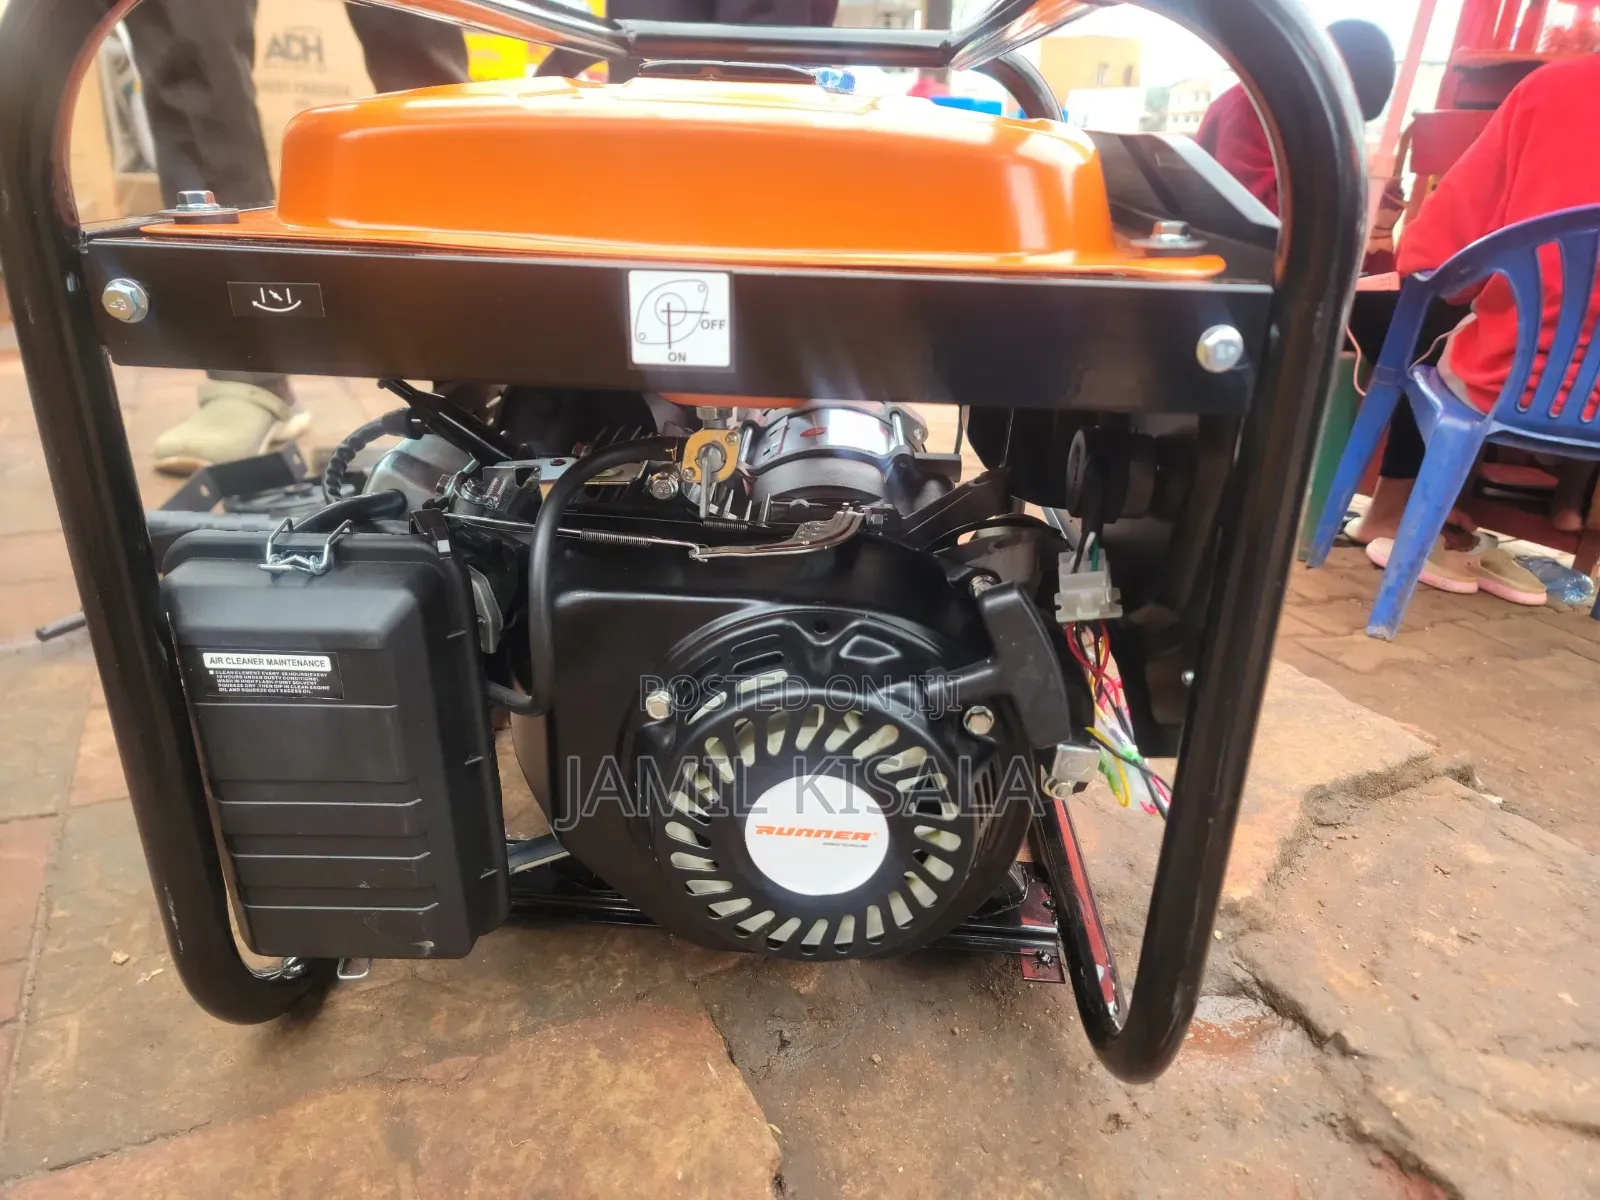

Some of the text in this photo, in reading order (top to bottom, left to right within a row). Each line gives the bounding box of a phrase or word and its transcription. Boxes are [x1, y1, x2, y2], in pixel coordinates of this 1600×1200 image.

[700, 319, 725, 330] OFF
[668, 352, 686, 362] ON
[209, 657, 326, 667] AIR CLEANER MAINTENANCE
[755, 825, 871, 841] RUNNER
